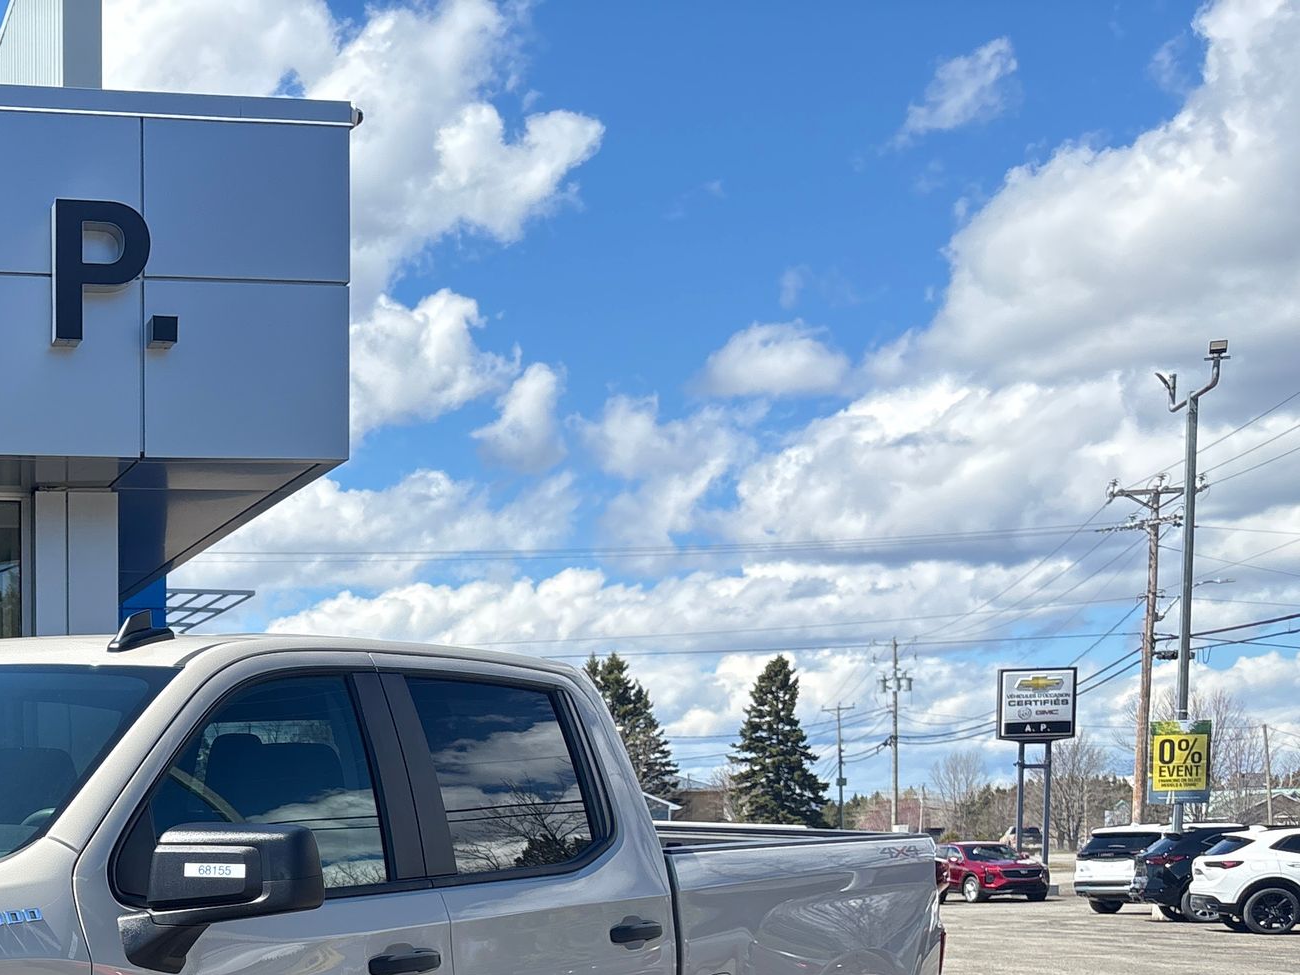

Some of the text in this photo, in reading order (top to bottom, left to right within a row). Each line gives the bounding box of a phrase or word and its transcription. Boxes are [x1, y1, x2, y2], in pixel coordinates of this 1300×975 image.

[50, 197, 179, 349] P.
[1008, 698, 1069, 707] CERTIFIÉS
[1158, 738, 1203, 765] 0%
[1158, 765, 1202, 777] EVENT
[198, 864, 232, 876] 68155
